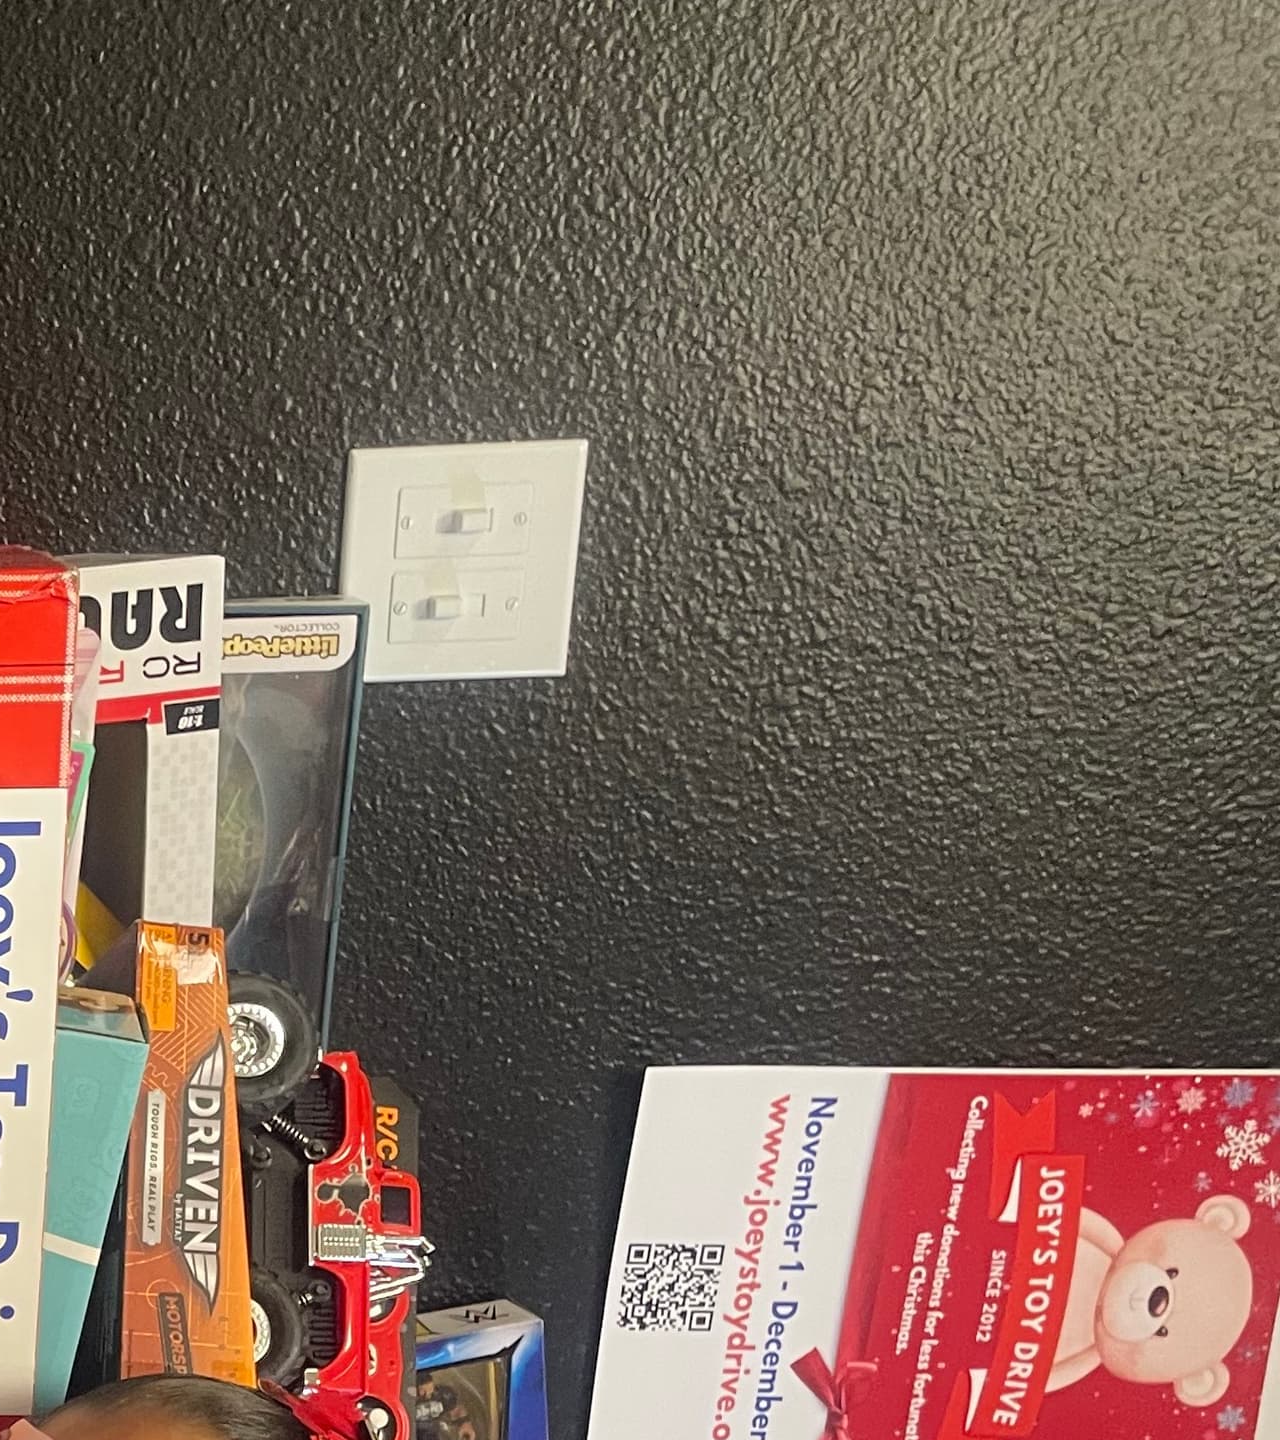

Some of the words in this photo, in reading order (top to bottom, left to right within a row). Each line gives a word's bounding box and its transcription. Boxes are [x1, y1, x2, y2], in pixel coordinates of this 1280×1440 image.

[143, 652, 201, 679] RC
[150, 1102, 161, 1138] TOUGH
[376, 1106, 399, 1160] R/C
[950, 1095, 988, 1180] Collecting
[148, 1176, 158, 1201] REAL
[183, 1088, 221, 1252] DRIVEN
[784, 1096, 838, 1253] November
[146, 1204, 157, 1232] PLAY
[946, 1183, 965, 1220] new
[1033, 1166, 1066, 1263] JOEY'S
[779, 1261, 805, 1271] 1
[912, 1232, 933, 1262] this
[928, 1224, 959, 1307] donations
[984, 1249, 1006, 1298] SINCE
[894, 1266, 926, 1356] Christmas.
[924, 1311, 943, 1336] for
[975, 1303, 997, 1342] 2012
[1020, 1274, 1054, 1333] TOY
[165, 1296, 188, 1375] MOTORSP
[916, 1340, 939, 1370] less
[991, 1342, 1039, 1427] DRIVE
